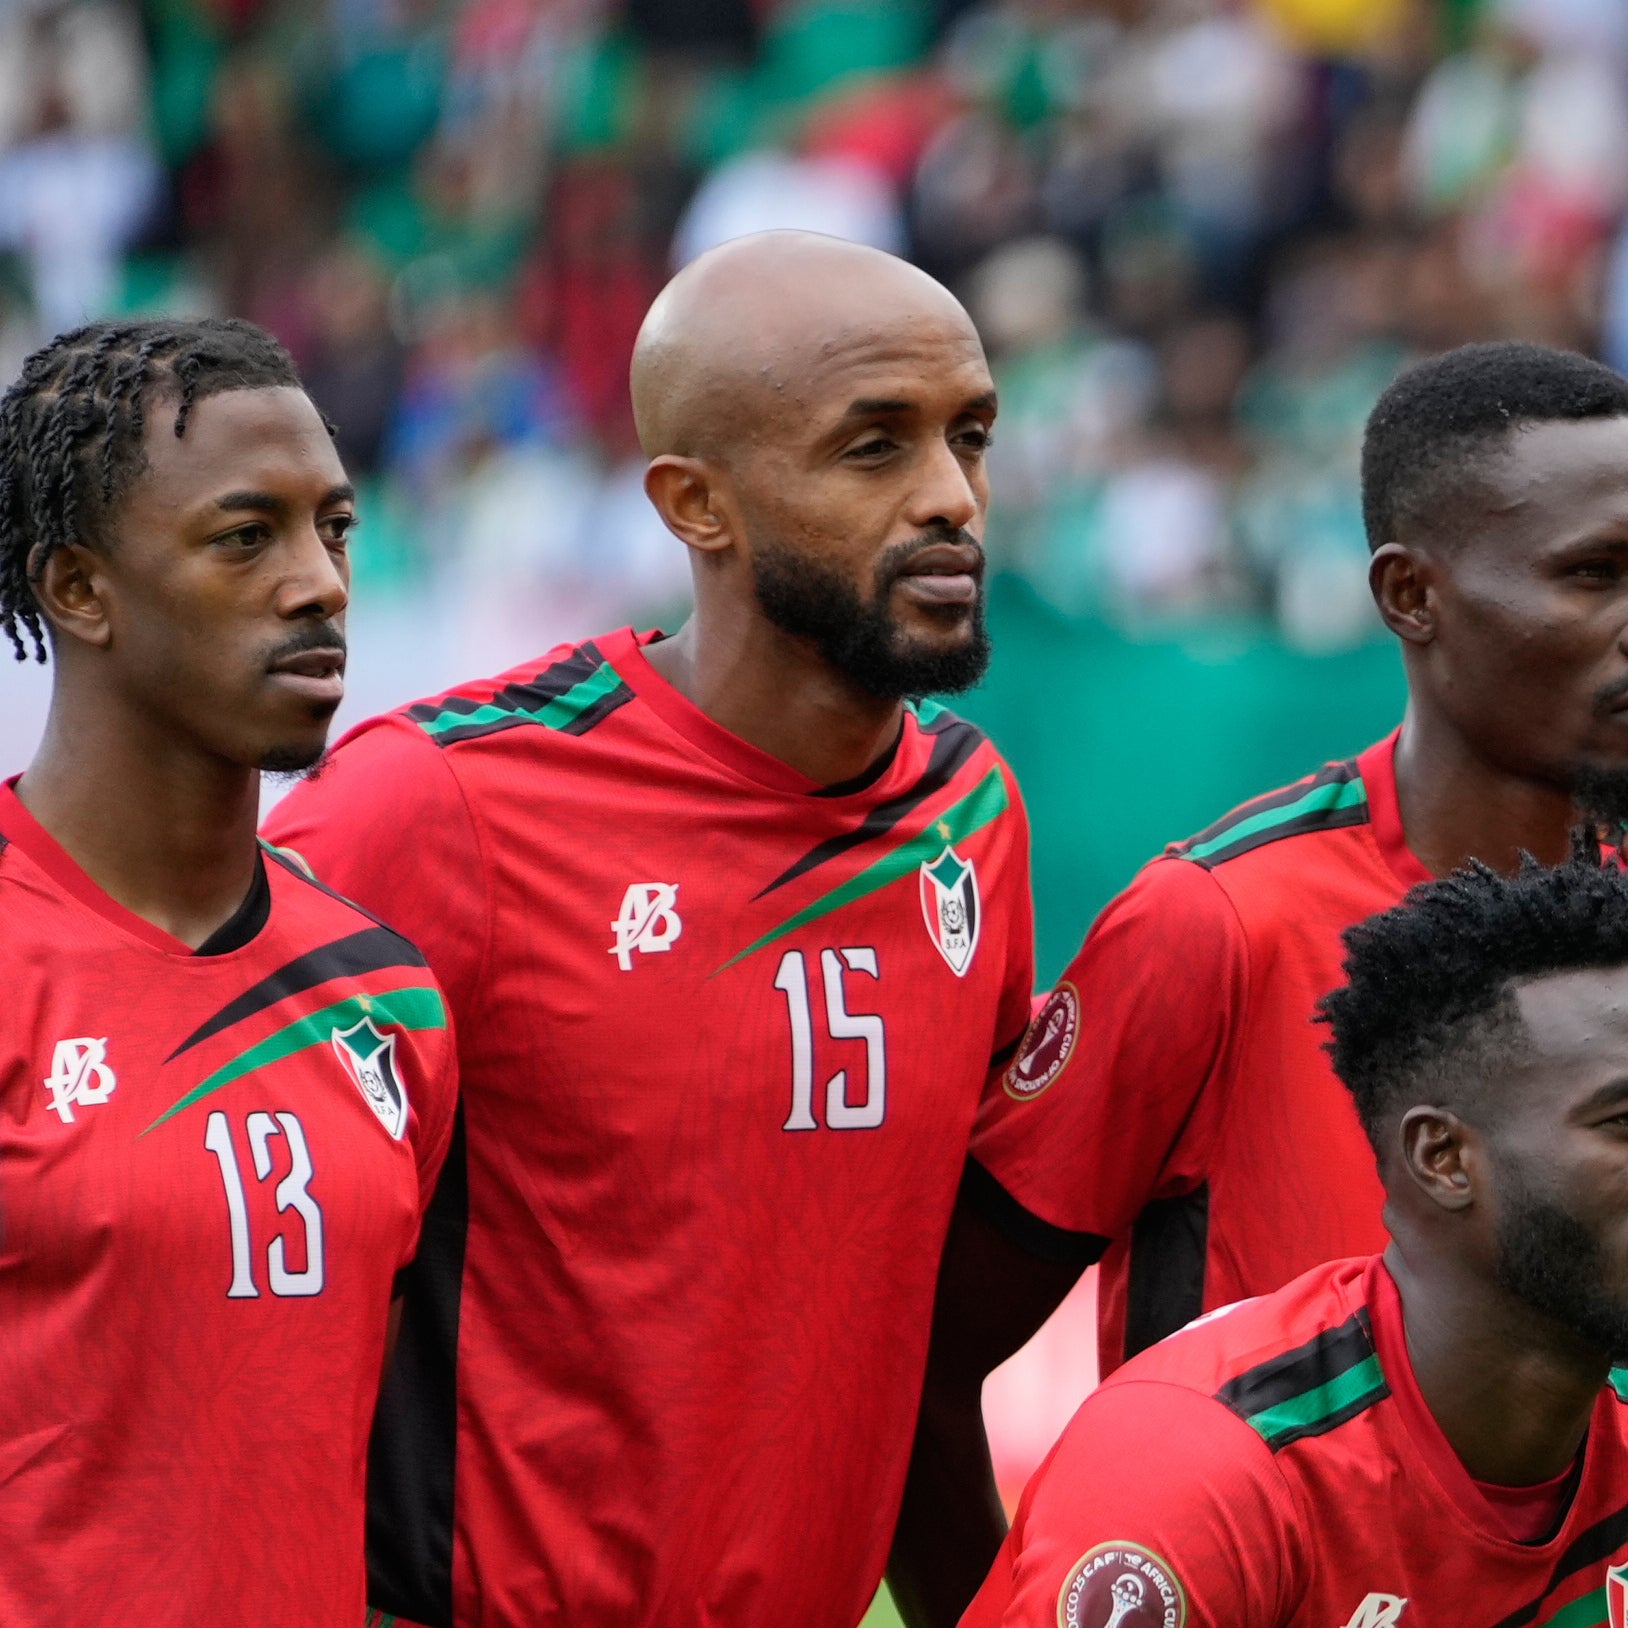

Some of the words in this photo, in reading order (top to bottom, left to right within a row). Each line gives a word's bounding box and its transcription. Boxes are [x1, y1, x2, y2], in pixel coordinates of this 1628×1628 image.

[774, 947, 886, 1131] 15
[205, 1111, 325, 1299] 13
[1072, 1574, 1085, 1592] 25
[1083, 1552, 1116, 1578] CAF
[1140, 1562, 1175, 1606] AFRICA
